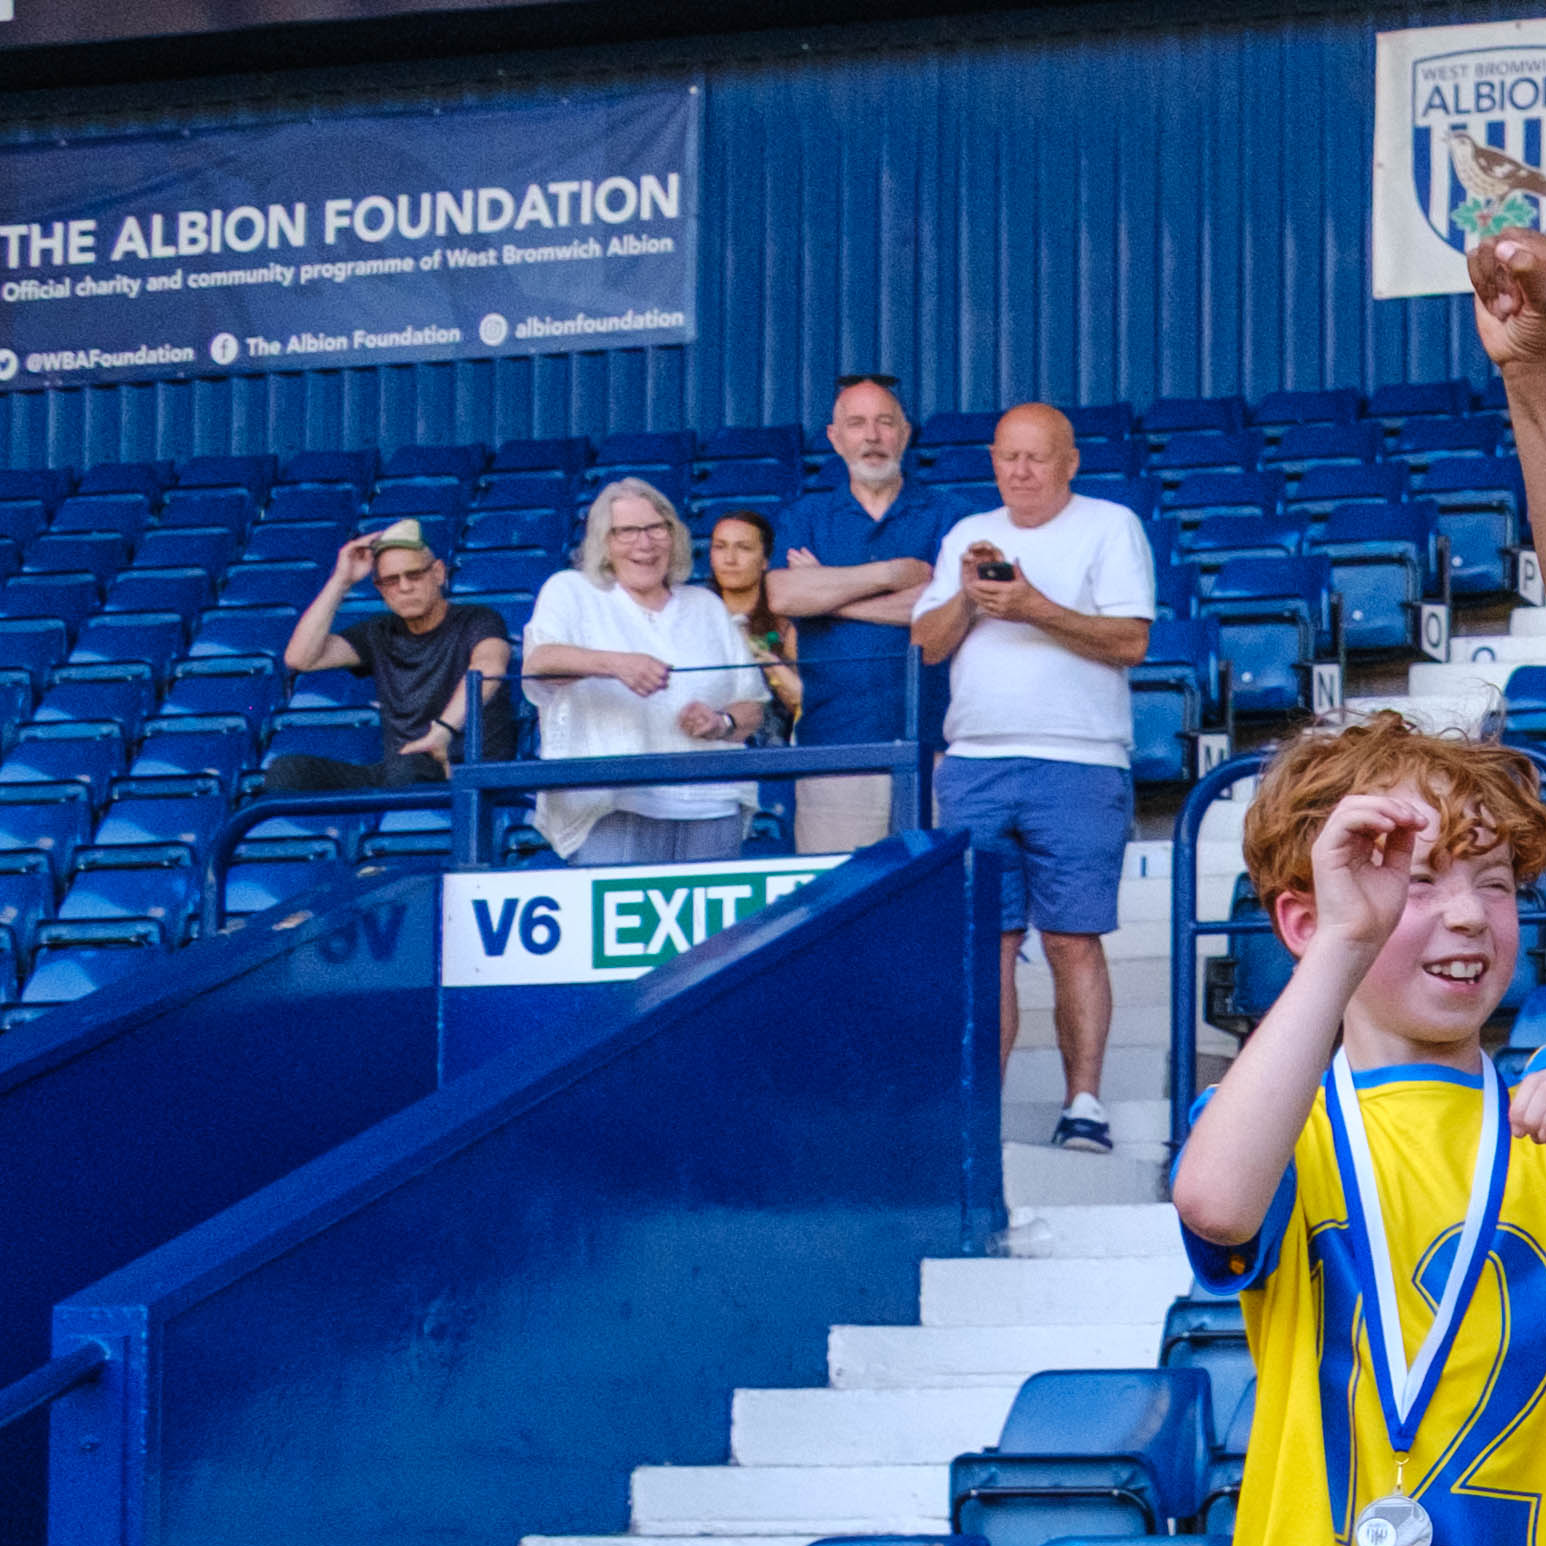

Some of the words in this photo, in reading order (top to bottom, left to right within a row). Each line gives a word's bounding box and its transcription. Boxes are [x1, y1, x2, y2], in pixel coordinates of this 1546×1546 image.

[1420, 64, 1470, 81] WEST
[0, 219, 97, 269] THE
[111, 203, 306, 262] ALBION
[324, 172, 680, 245] FOUNDATION
[2, 278, 71, 302] Official
[75, 274, 142, 299] charity
[146, 269, 183, 291] and
[187, 262, 296, 288] community
[300, 256, 415, 285] programme
[419, 249, 442, 270] of
[446, 247, 498, 269] West
[502, 237, 600, 265] Bromwich
[606, 233, 675, 257] Albion
[245, 336, 282, 356] The
[285, 332, 348, 354] Albion
[353, 324, 462, 349] Foundation
[515, 308, 685, 340] albionfoundation
[26, 344, 195, 373] @WBAFoundation
[472, 895, 562, 957] V6
[603, 884, 753, 957] EXIT
